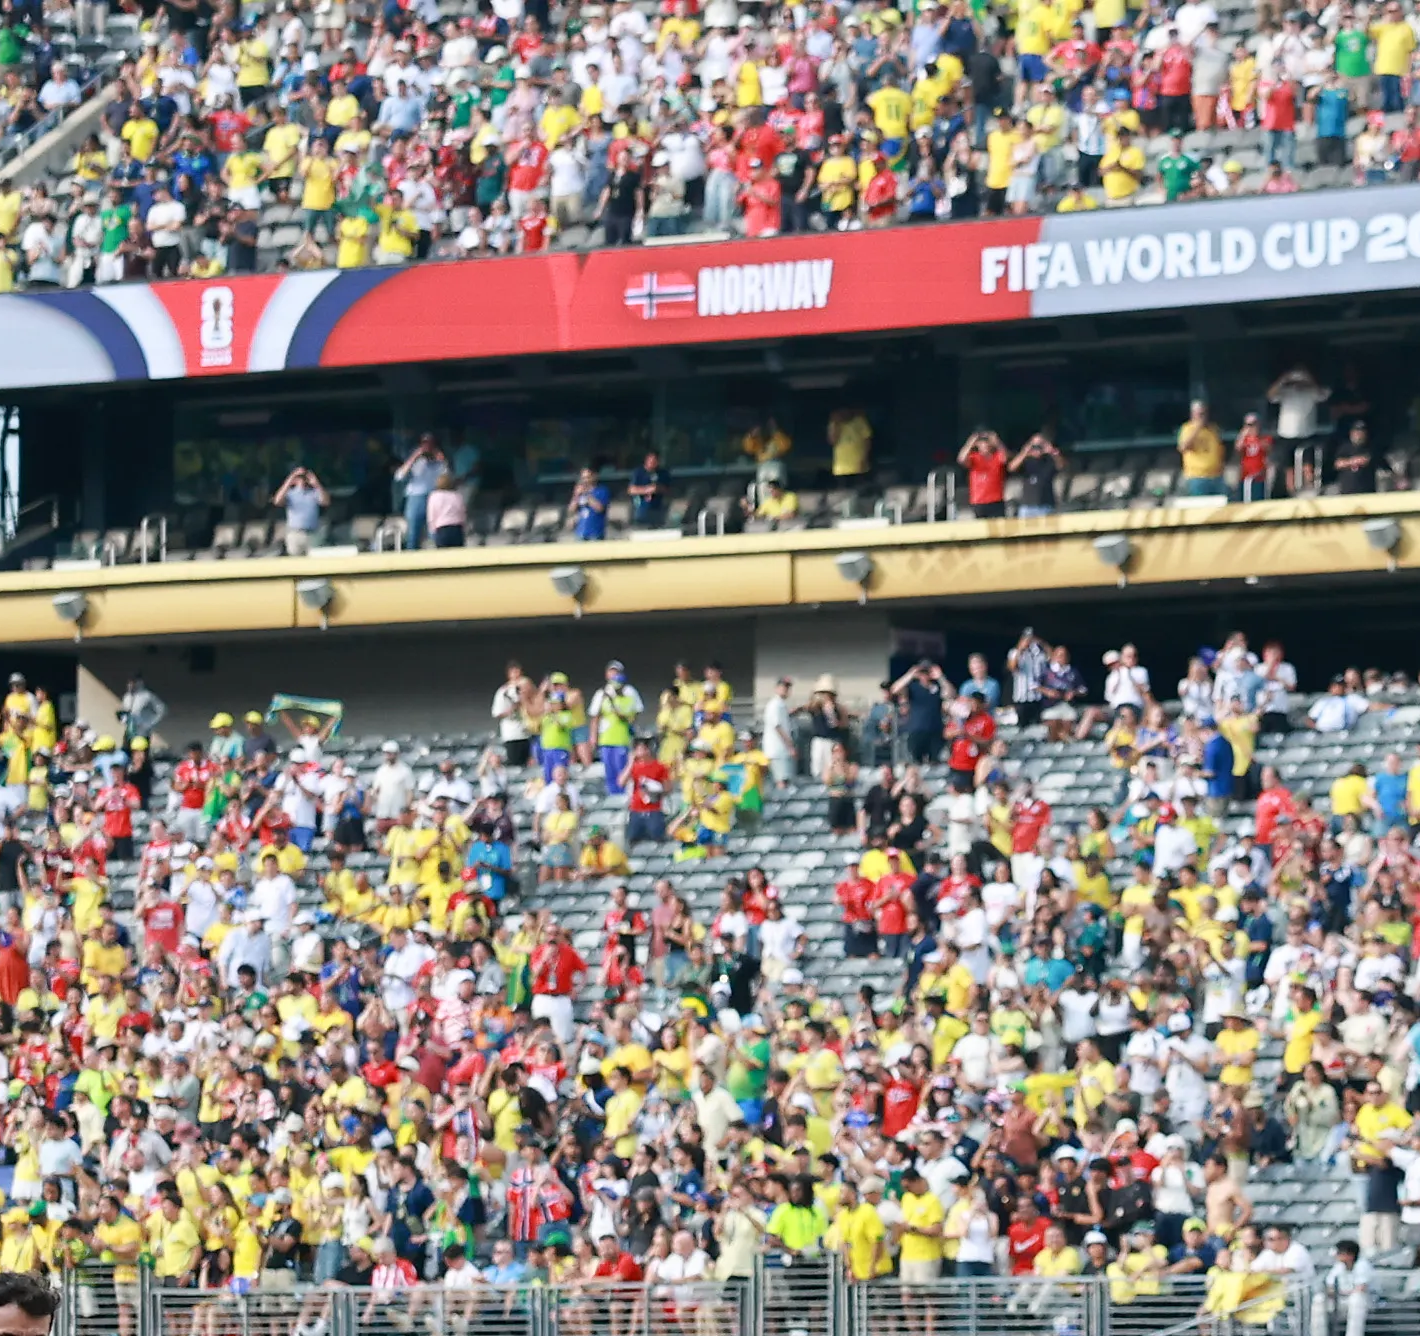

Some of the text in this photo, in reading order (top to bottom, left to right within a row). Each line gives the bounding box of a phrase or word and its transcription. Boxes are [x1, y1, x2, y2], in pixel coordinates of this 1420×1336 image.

[697, 258, 833, 317] NORWAY
[981, 242, 1080, 294] FIFA
[1084, 226, 1256, 286] WORLD
[1261, 217, 1360, 270] CUP
